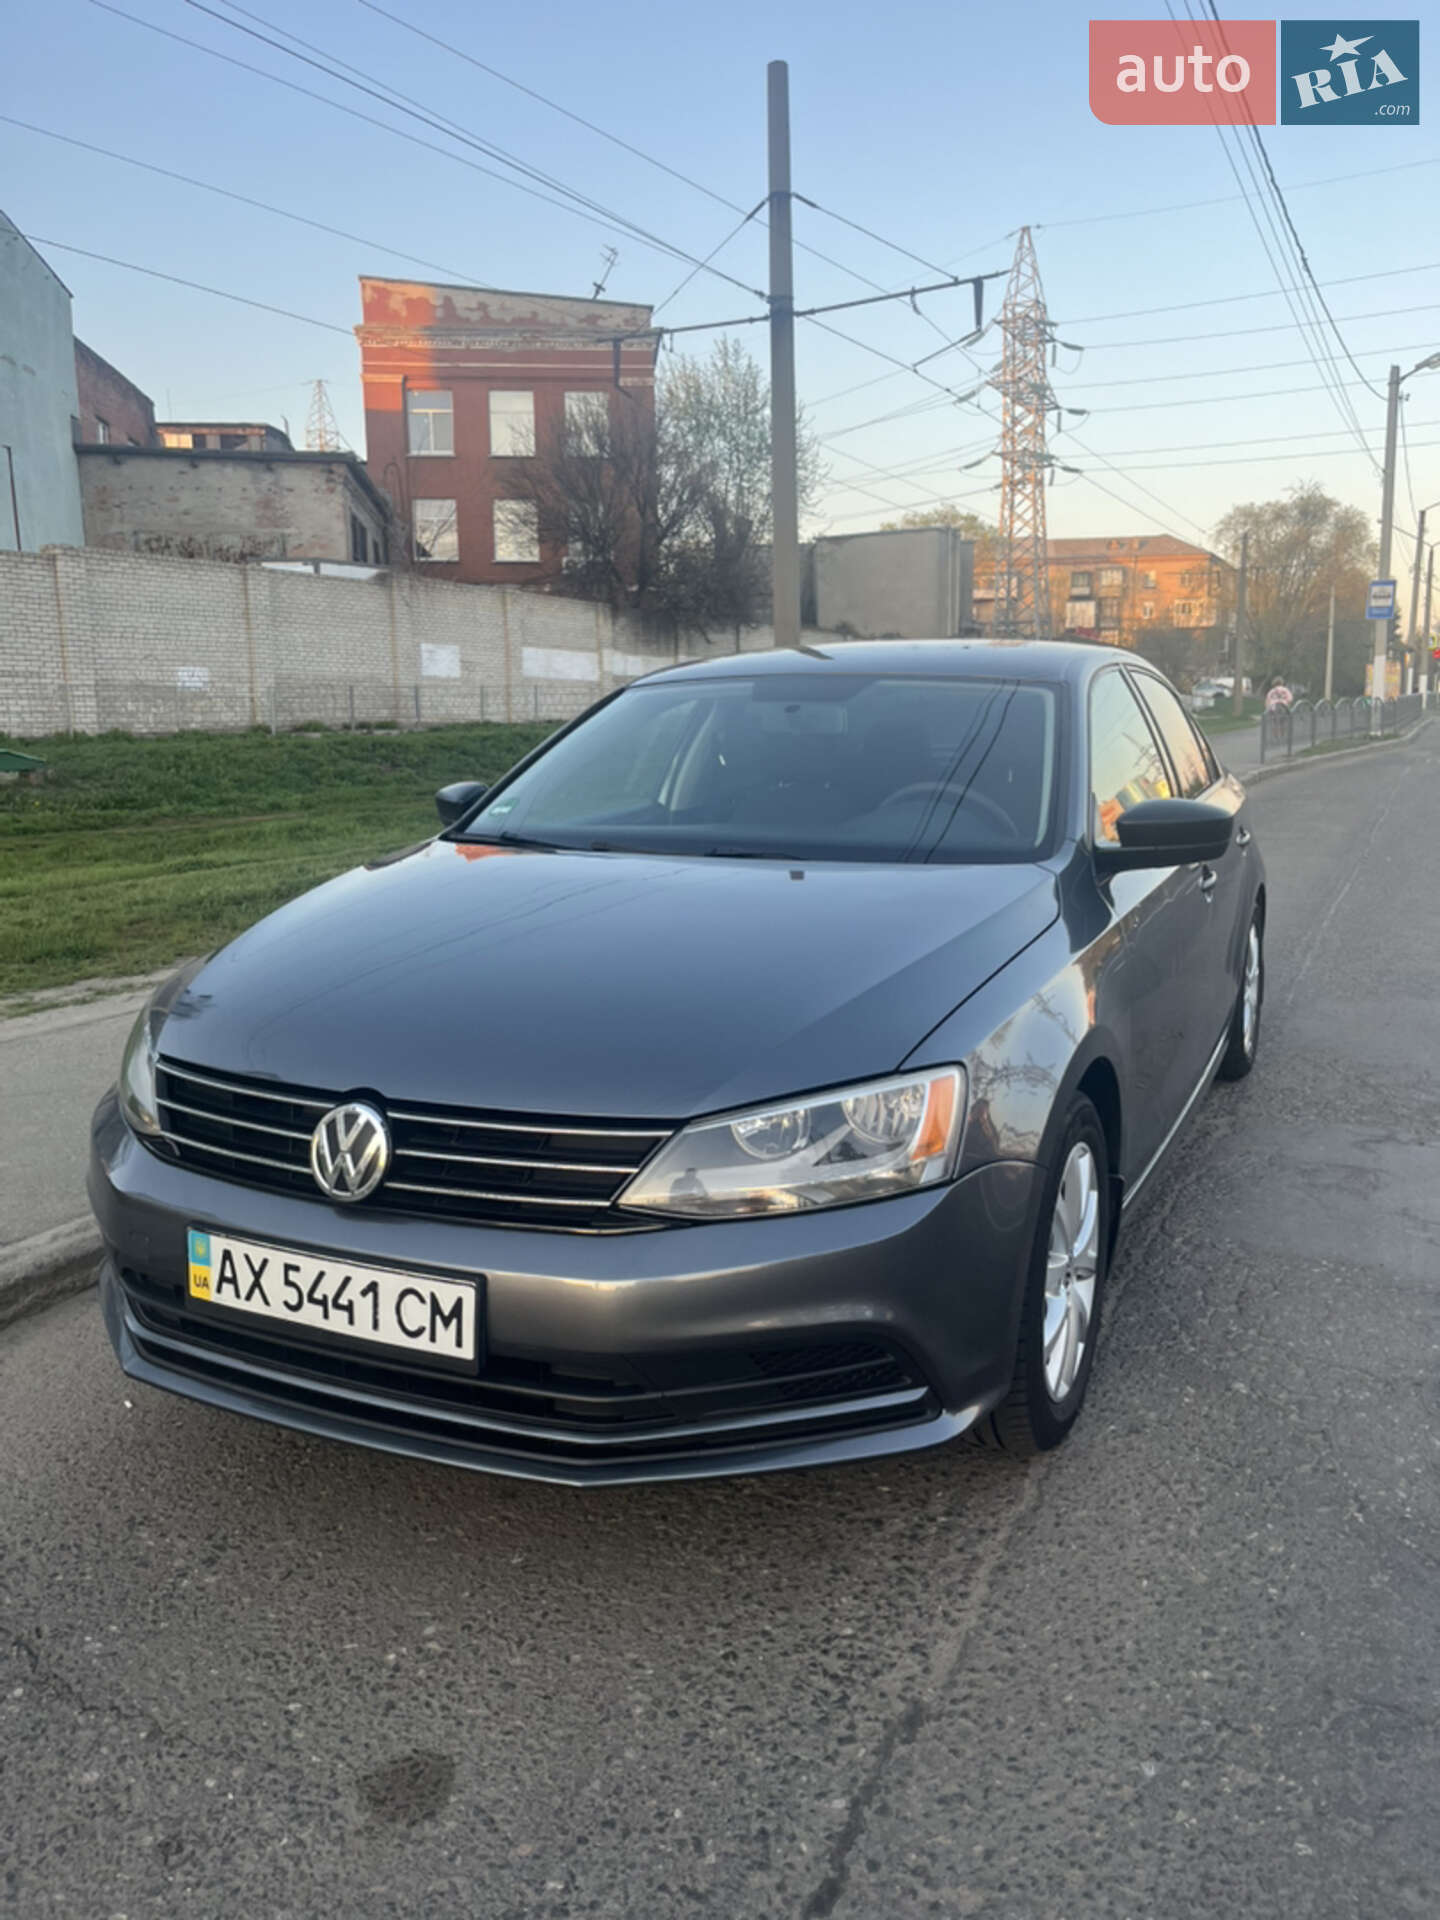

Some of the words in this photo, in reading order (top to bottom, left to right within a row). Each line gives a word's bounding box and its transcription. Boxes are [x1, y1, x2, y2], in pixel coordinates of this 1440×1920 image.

[313, 1104, 387, 1200] VW
[193, 1274, 209, 1290] UA
[215, 1249, 270, 1307] AX
[283, 1262, 380, 1331] 5441
[395, 1287, 463, 1348] CM
